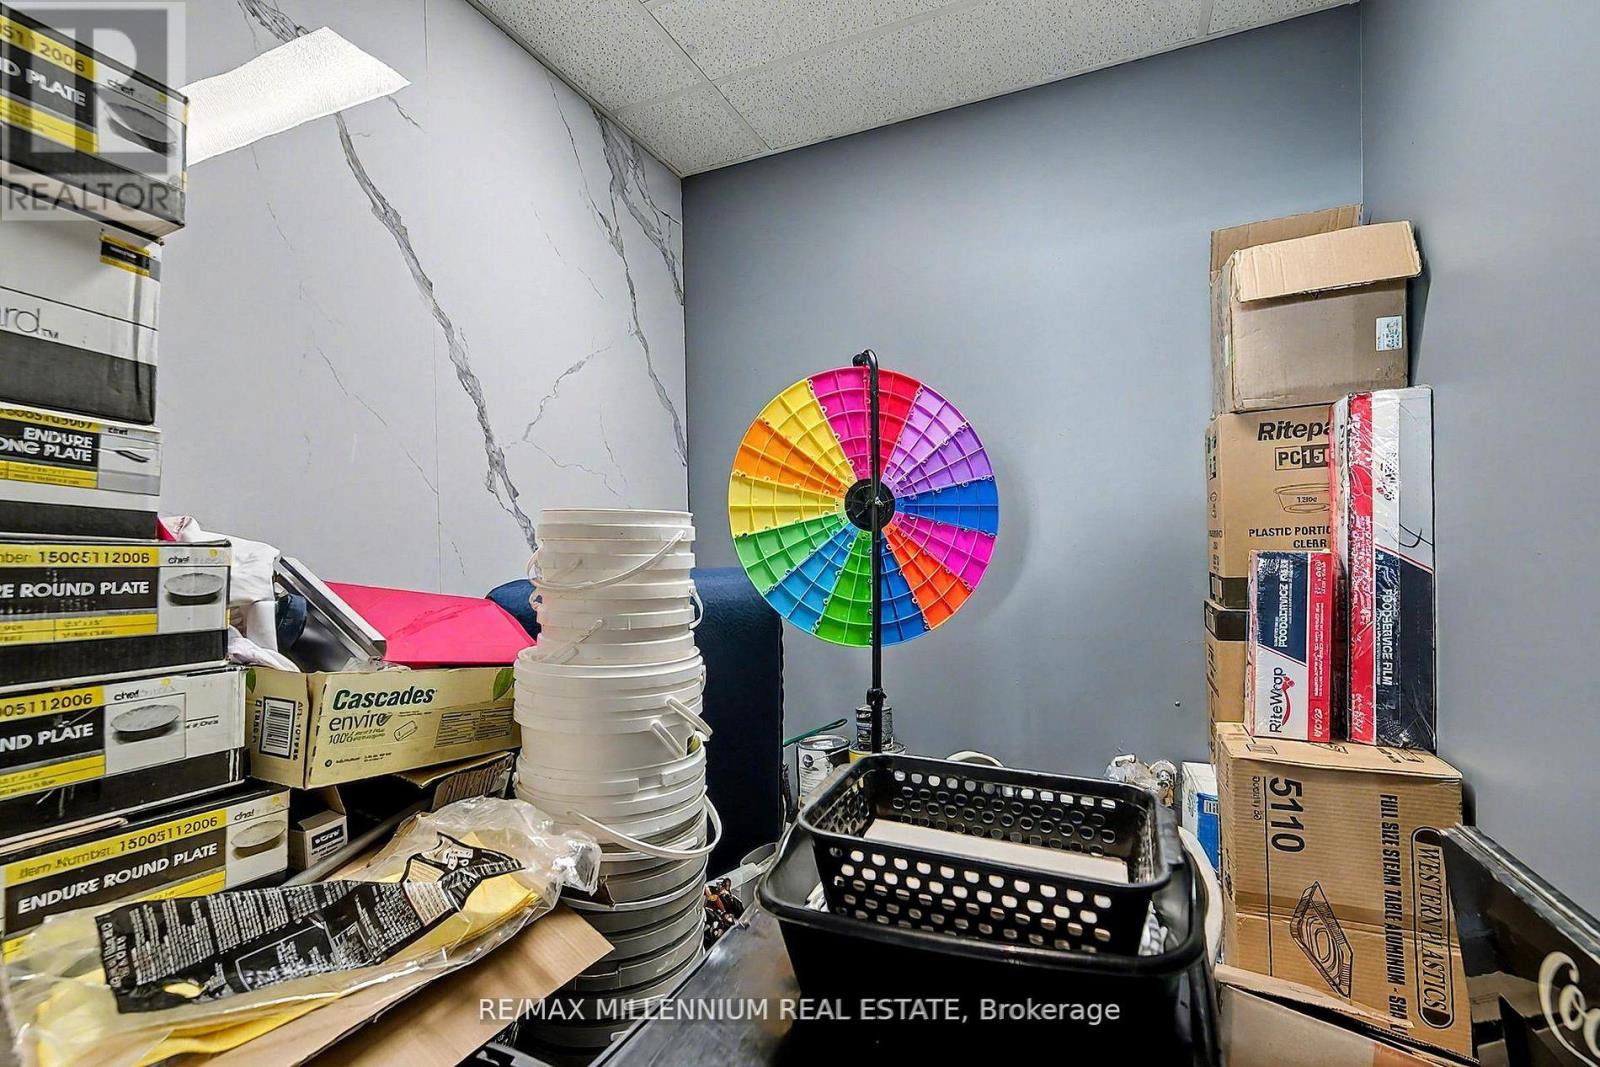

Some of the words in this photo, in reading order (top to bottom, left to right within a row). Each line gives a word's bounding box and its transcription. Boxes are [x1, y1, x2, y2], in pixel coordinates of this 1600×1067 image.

[25, 67, 87, 107] PLATE
[23, 427, 93, 448] ENDURE
[43, 444, 92, 462] PLATE
[1248, 527, 1293, 538] PLASTIC
[1293, 538, 1328, 549] CLEAR
[38, 551, 151, 564] 15005112006
[0, 583, 15, 599] E
[20, 581, 96, 599] ROUND
[100, 581, 150, 596] PLATE
[1381, 661, 1394, 686] FILM
[0, 693, 93, 718] 05112006
[332, 686, 436, 711] Cascades
[1269, 666, 1287, 734] RiteWrap
[37, 722, 94, 746] PLATE
[1270, 777, 1306, 853] 5110
[1380, 794, 1399, 818] FULL
[119, 816, 218, 852] 15005112006
[1382, 821, 1400, 846] SIZE
[18, 877, 100, 915] ENDURE
[103, 858, 169, 889] ROUND
[173, 842, 218, 867] PLATE
[1382, 848, 1401, 887] STEAM
[1418, 847, 1443, 931] WESTERN
[1384, 889, 1403, 921] TABLE
[1385, 921, 1406, 985] ALUMINUM
[1420, 928, 1448, 1012] PLASTICS
